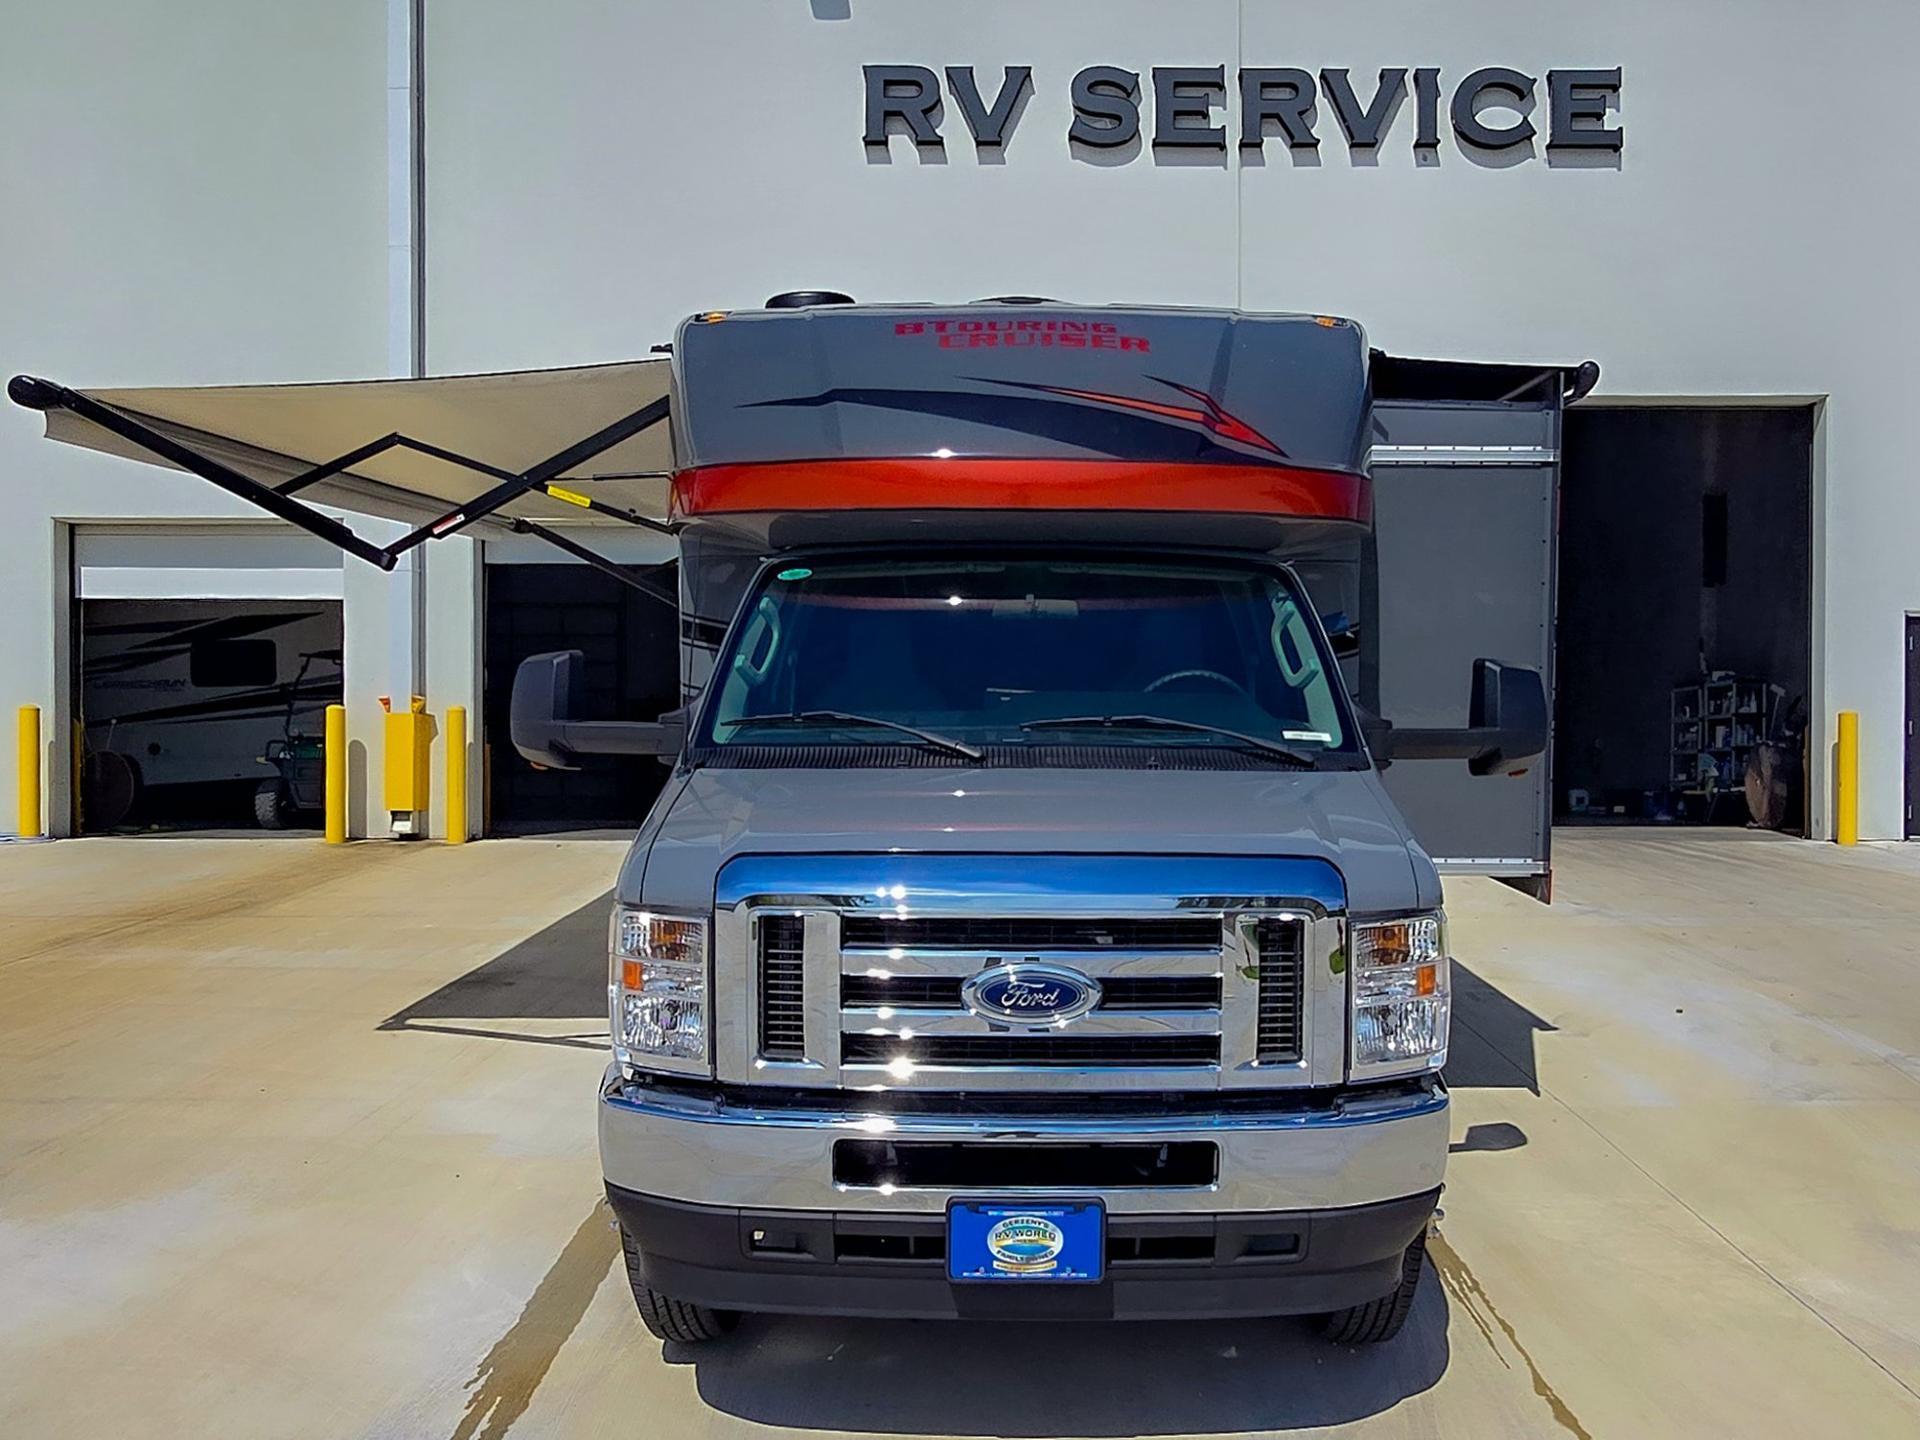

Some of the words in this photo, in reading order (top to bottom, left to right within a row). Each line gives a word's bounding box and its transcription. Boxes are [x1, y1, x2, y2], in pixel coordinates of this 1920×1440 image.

[862, 64, 1032, 149] RV
[1068, 64, 1624, 150] SERVICE
[938, 332, 1151, 352] CRUISER
[1001, 982, 1060, 1007] Ford
[995, 1230, 1012, 1241] RV
[1015, 1229, 1057, 1242] WORLD
